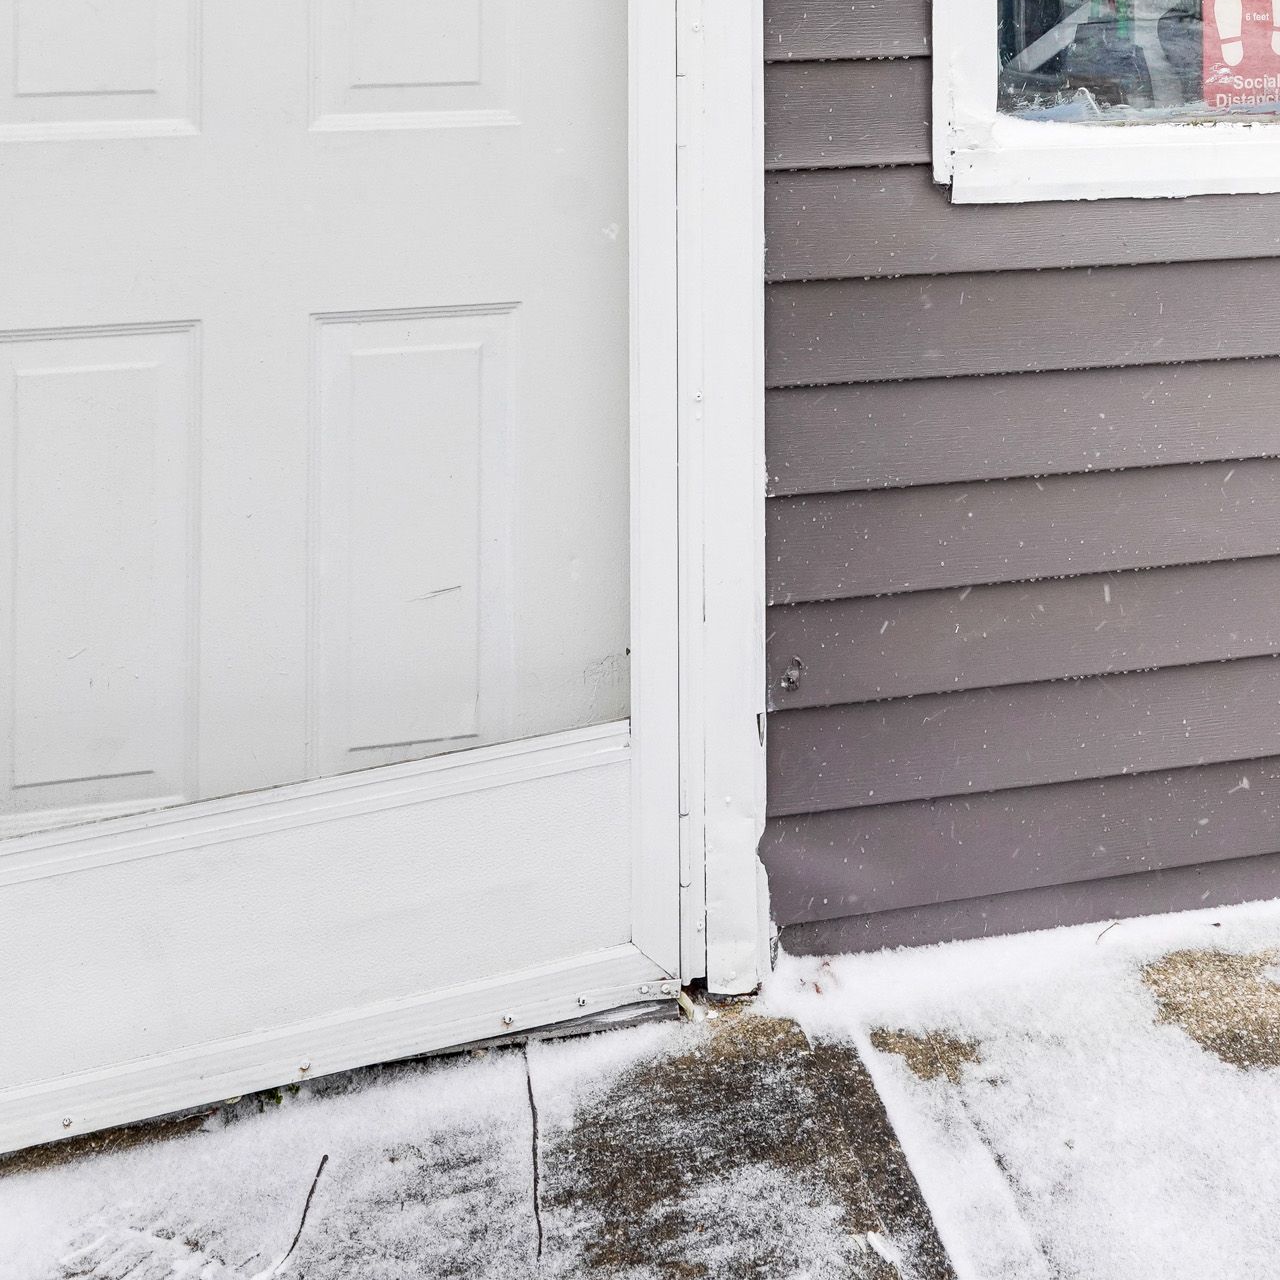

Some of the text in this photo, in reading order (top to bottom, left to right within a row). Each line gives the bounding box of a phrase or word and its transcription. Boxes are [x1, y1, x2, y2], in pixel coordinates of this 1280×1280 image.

[1245, 11, 1270, 21] 6 feet
[1233, 72, 1280, 90] Social
